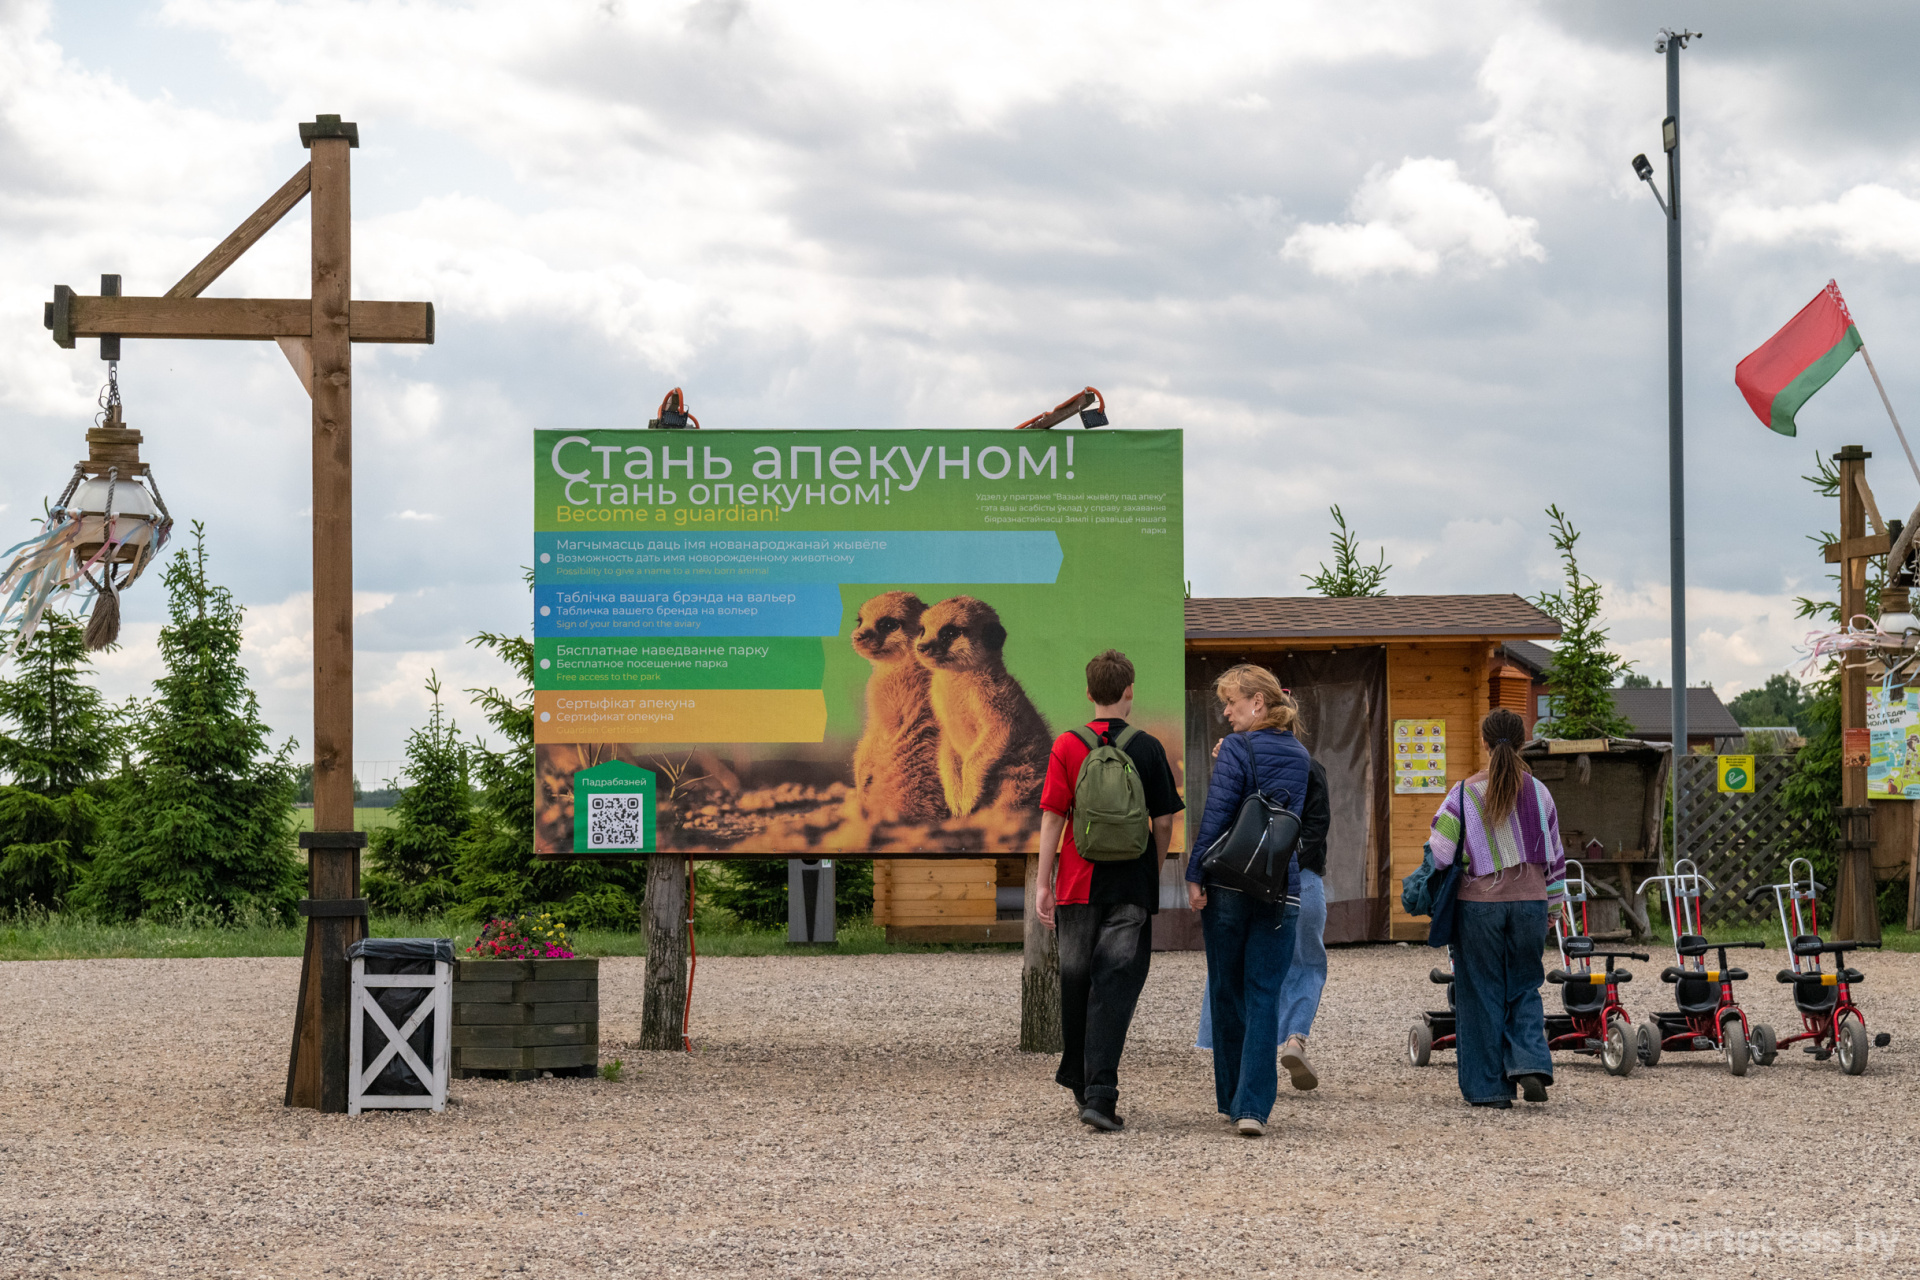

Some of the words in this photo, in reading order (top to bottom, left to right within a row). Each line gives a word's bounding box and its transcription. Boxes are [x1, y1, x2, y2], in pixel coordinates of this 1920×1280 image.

[551, 436, 733, 480] Стань
[752, 435, 1075, 492] апекуном!
[564, 478, 677, 506] Стань
[688, 478, 891, 513] опекуном!
[976, 493, 1001, 502] Удзел
[1009, 494, 1051, 502] праграме
[1053, 493, 1085, 501] "Вазьмі
[1087, 492, 1119, 502] жывёлу
[1121, 494, 1137, 502] пад
[1139, 493, 1167, 502] апеку"
[1019, 504, 1055, 512] асабісты
[1091, 505, 1120, 513] справу
[556, 505, 648, 522] Become
[655, 509, 667, 522] a
[674, 504, 779, 526] guardian!
[1065, 515, 1089, 523] Зямлі
[556, 539, 644, 551] Магчымасць
[647, 540, 680, 551] даць
[684, 538, 706, 550] імя
[709, 539, 830, 551] нованароджанай
[833, 539, 887, 550] жывёле
[556, 553, 633, 563] Возможность
[635, 554, 660, 564] дать
[663, 554, 686, 562] имя
[689, 554, 789, 564] новорожденному
[791, 554, 855, 564] животному
[556, 566, 601, 576] Possibility
[604, 567, 613, 575] to
[615, 567, 635, 576] give
[673, 567, 682, 575] to
[714, 567, 735, 575] born
[738, 567, 769, 575] animal
[556, 591, 616, 603] Таблічка
[619, 593, 669, 603] вашага
[673, 591, 723, 604] брэнда
[727, 593, 743, 602] на
[747, 593, 796, 605] вальер
[556, 605, 610, 616] Табличка
[612, 606, 654, 615] вашего
[656, 605, 698, 616] бренда
[701, 606, 715, 615] на
[718, 606, 758, 616] вольер
[556, 620, 577, 630] Sign
[578, 620, 589, 628] of
[590, 621, 610, 630] your
[612, 620, 640, 628] brand
[656, 620, 673, 628] the
[674, 620, 701, 630] aviary
[556, 645, 638, 656] Бясплатнае
[641, 646, 725, 657] наведванне
[728, 646, 769, 658] парку
[556, 659, 624, 669] Бесплатное
[626, 660, 692, 669] посещение
[695, 660, 728, 670] парка
[556, 673, 577, 681] Free
[611, 673, 620, 681] to
[622, 673, 639, 681] the
[640, 673, 661, 683] park
[556, 697, 636, 711] Сертыфікат
[639, 698, 696, 710] апекуна
[556, 712, 624, 723] Сертификат
[627, 712, 674, 722] опекуна
[582, 777, 647, 788] Падрабязней
